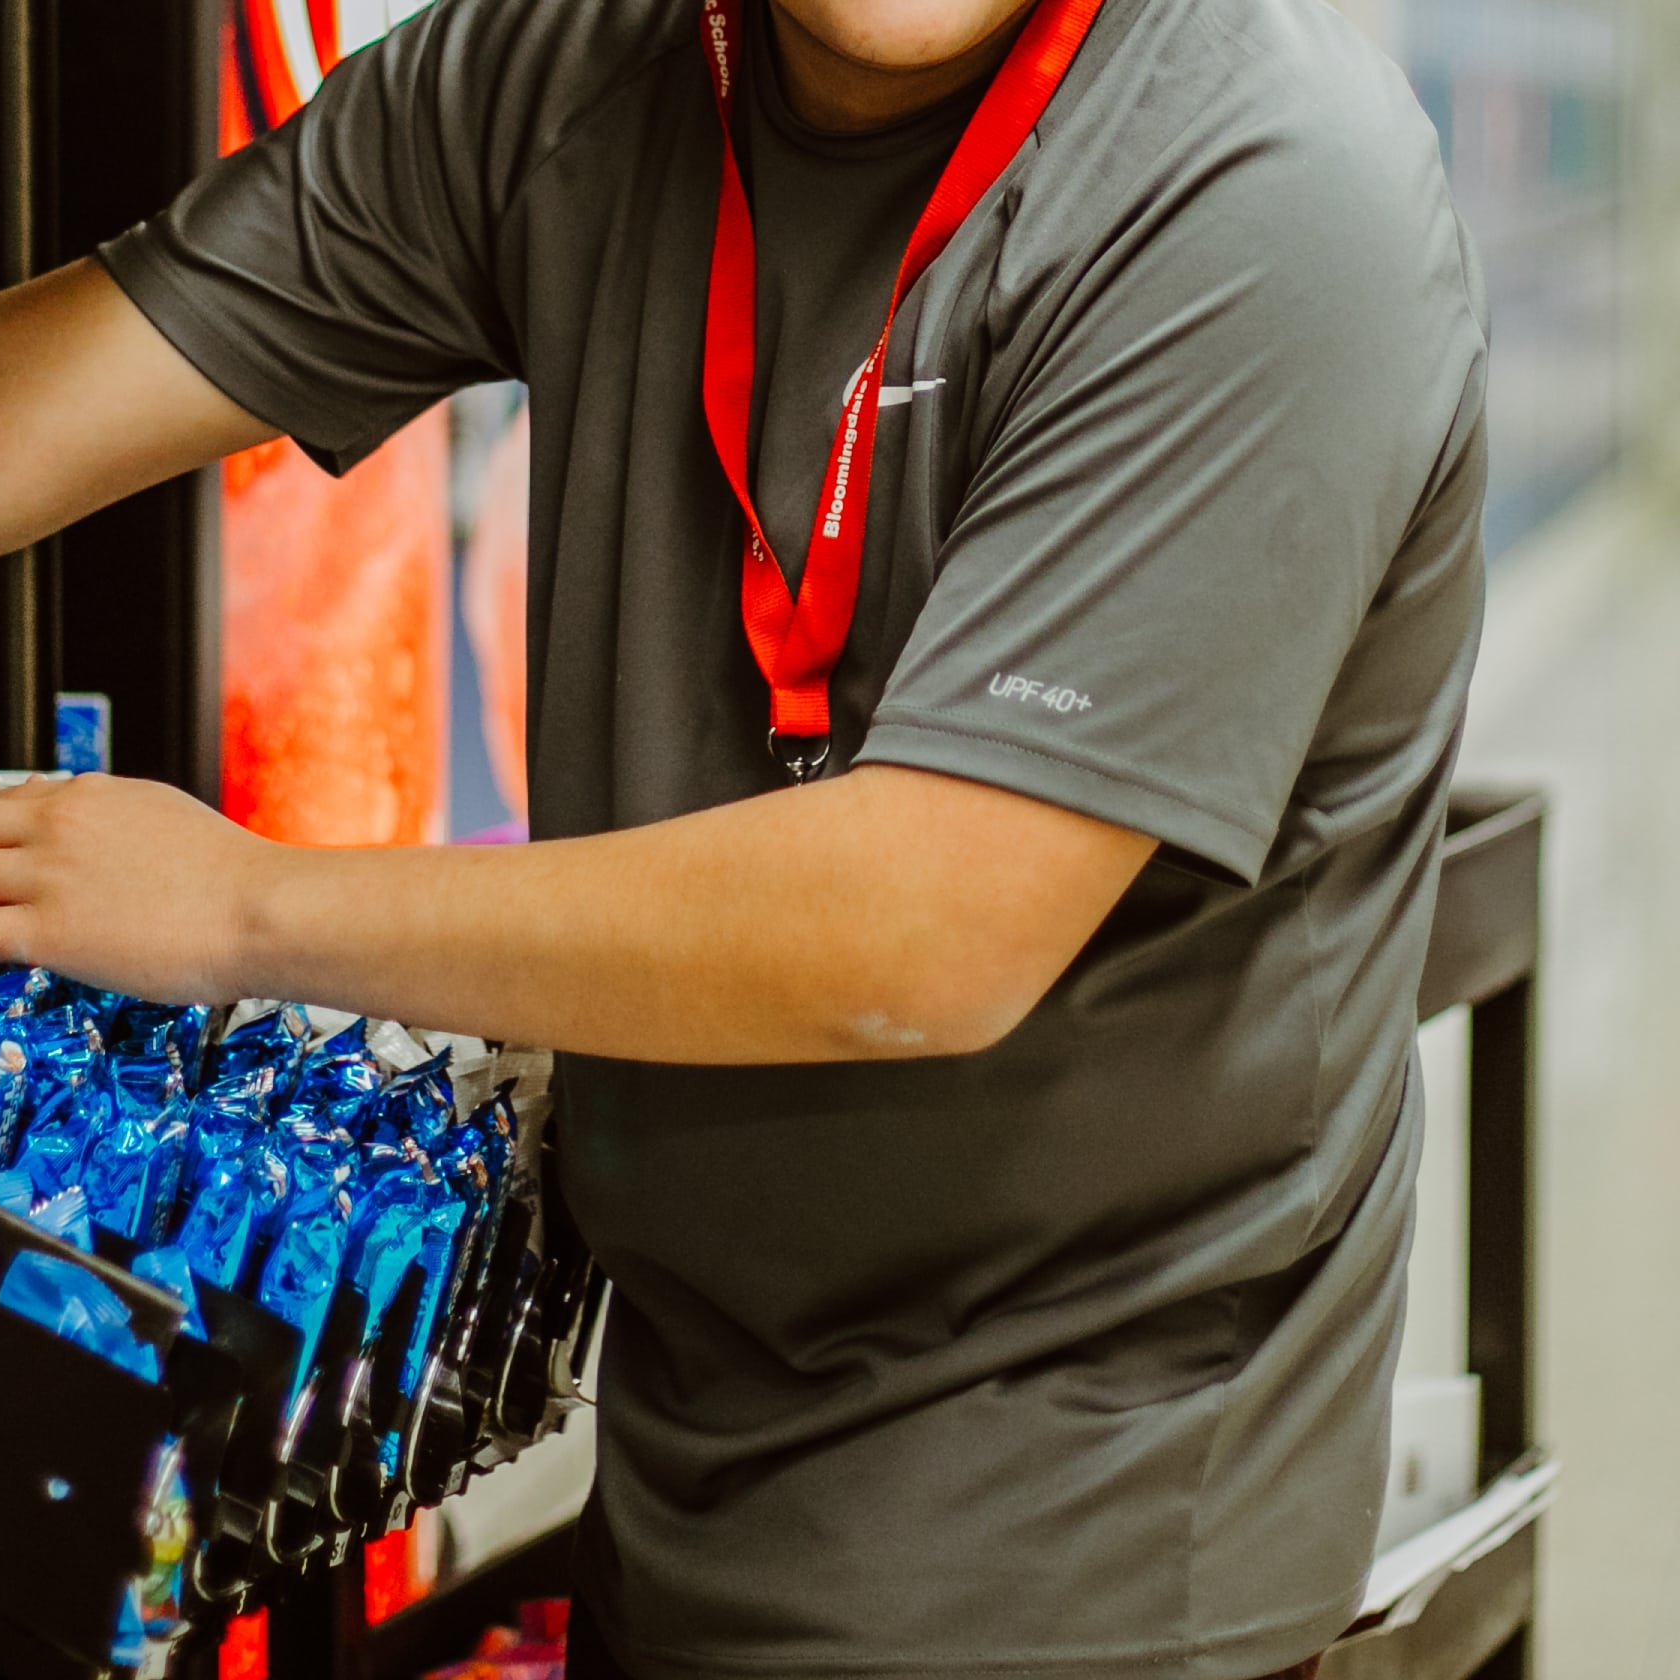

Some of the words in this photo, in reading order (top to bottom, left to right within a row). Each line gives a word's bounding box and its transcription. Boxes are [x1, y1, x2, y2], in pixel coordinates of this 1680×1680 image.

[823, 379, 868, 538] Bloomingdale
[988, 671, 1044, 702] UPF
[1040, 685, 1093, 713] 40+
